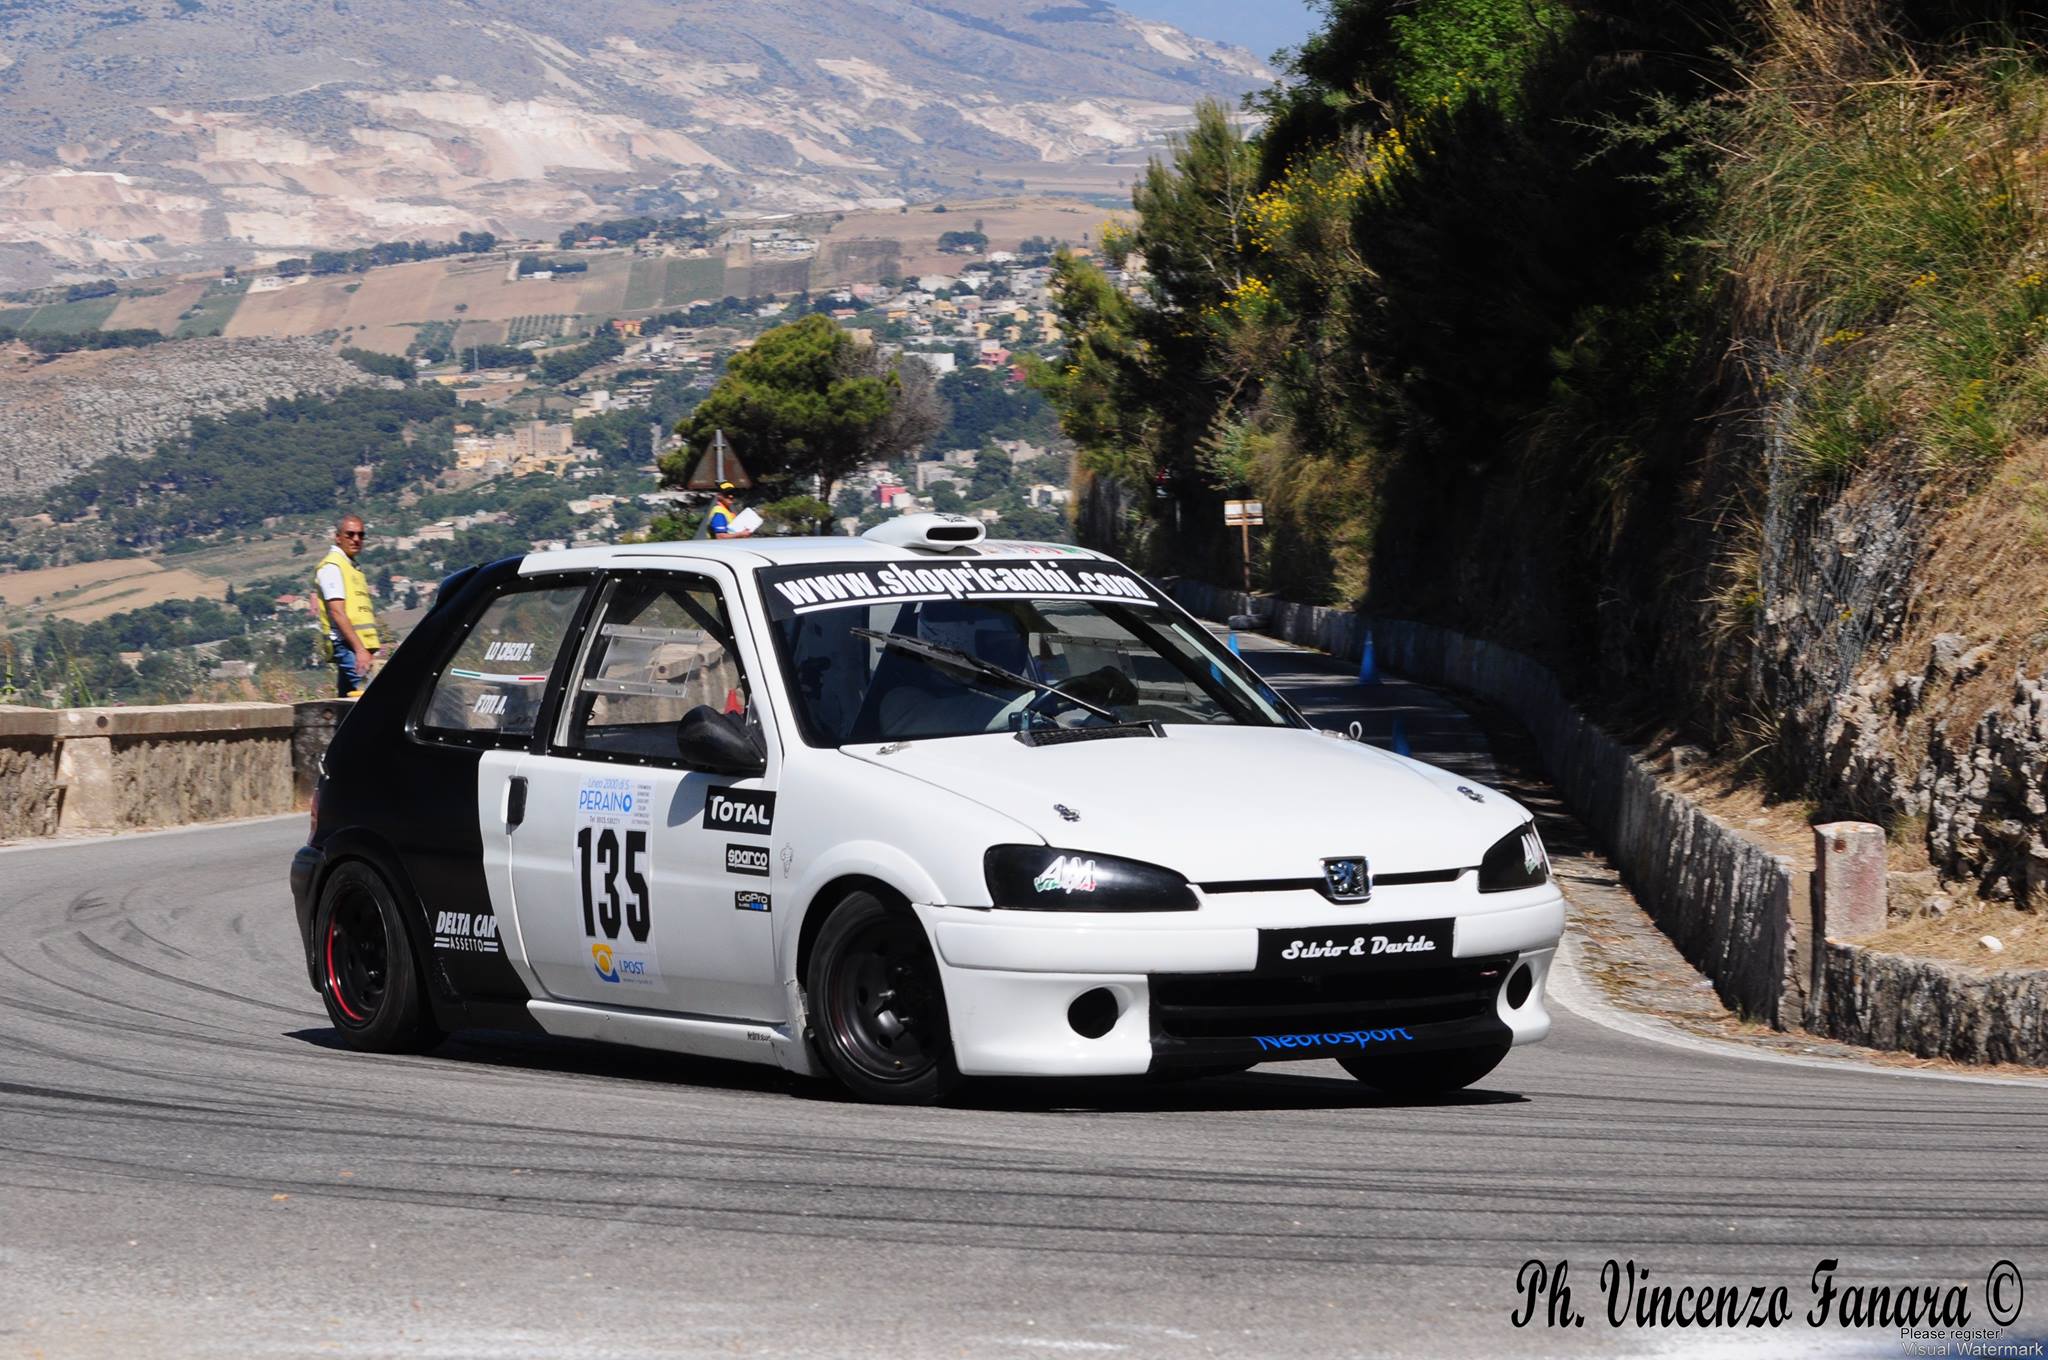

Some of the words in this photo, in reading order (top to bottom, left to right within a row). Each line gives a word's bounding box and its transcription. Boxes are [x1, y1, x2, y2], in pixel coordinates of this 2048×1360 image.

[774, 561, 1149, 603] www.shopricambi.com
[579, 790, 632, 812] PERAINO
[727, 849, 768, 867] sparco
[577, 827, 651, 942] 135
[737, 893, 768, 904] GoPro
[435, 910, 471, 936] DELTA
[473, 914, 498, 938] CAR
[449, 936, 484, 952] ASSETTO
[1281, 940, 1349, 960] Silvio
[1349, 937, 1365, 955] &
[1370, 935, 1436, 955] Davide
